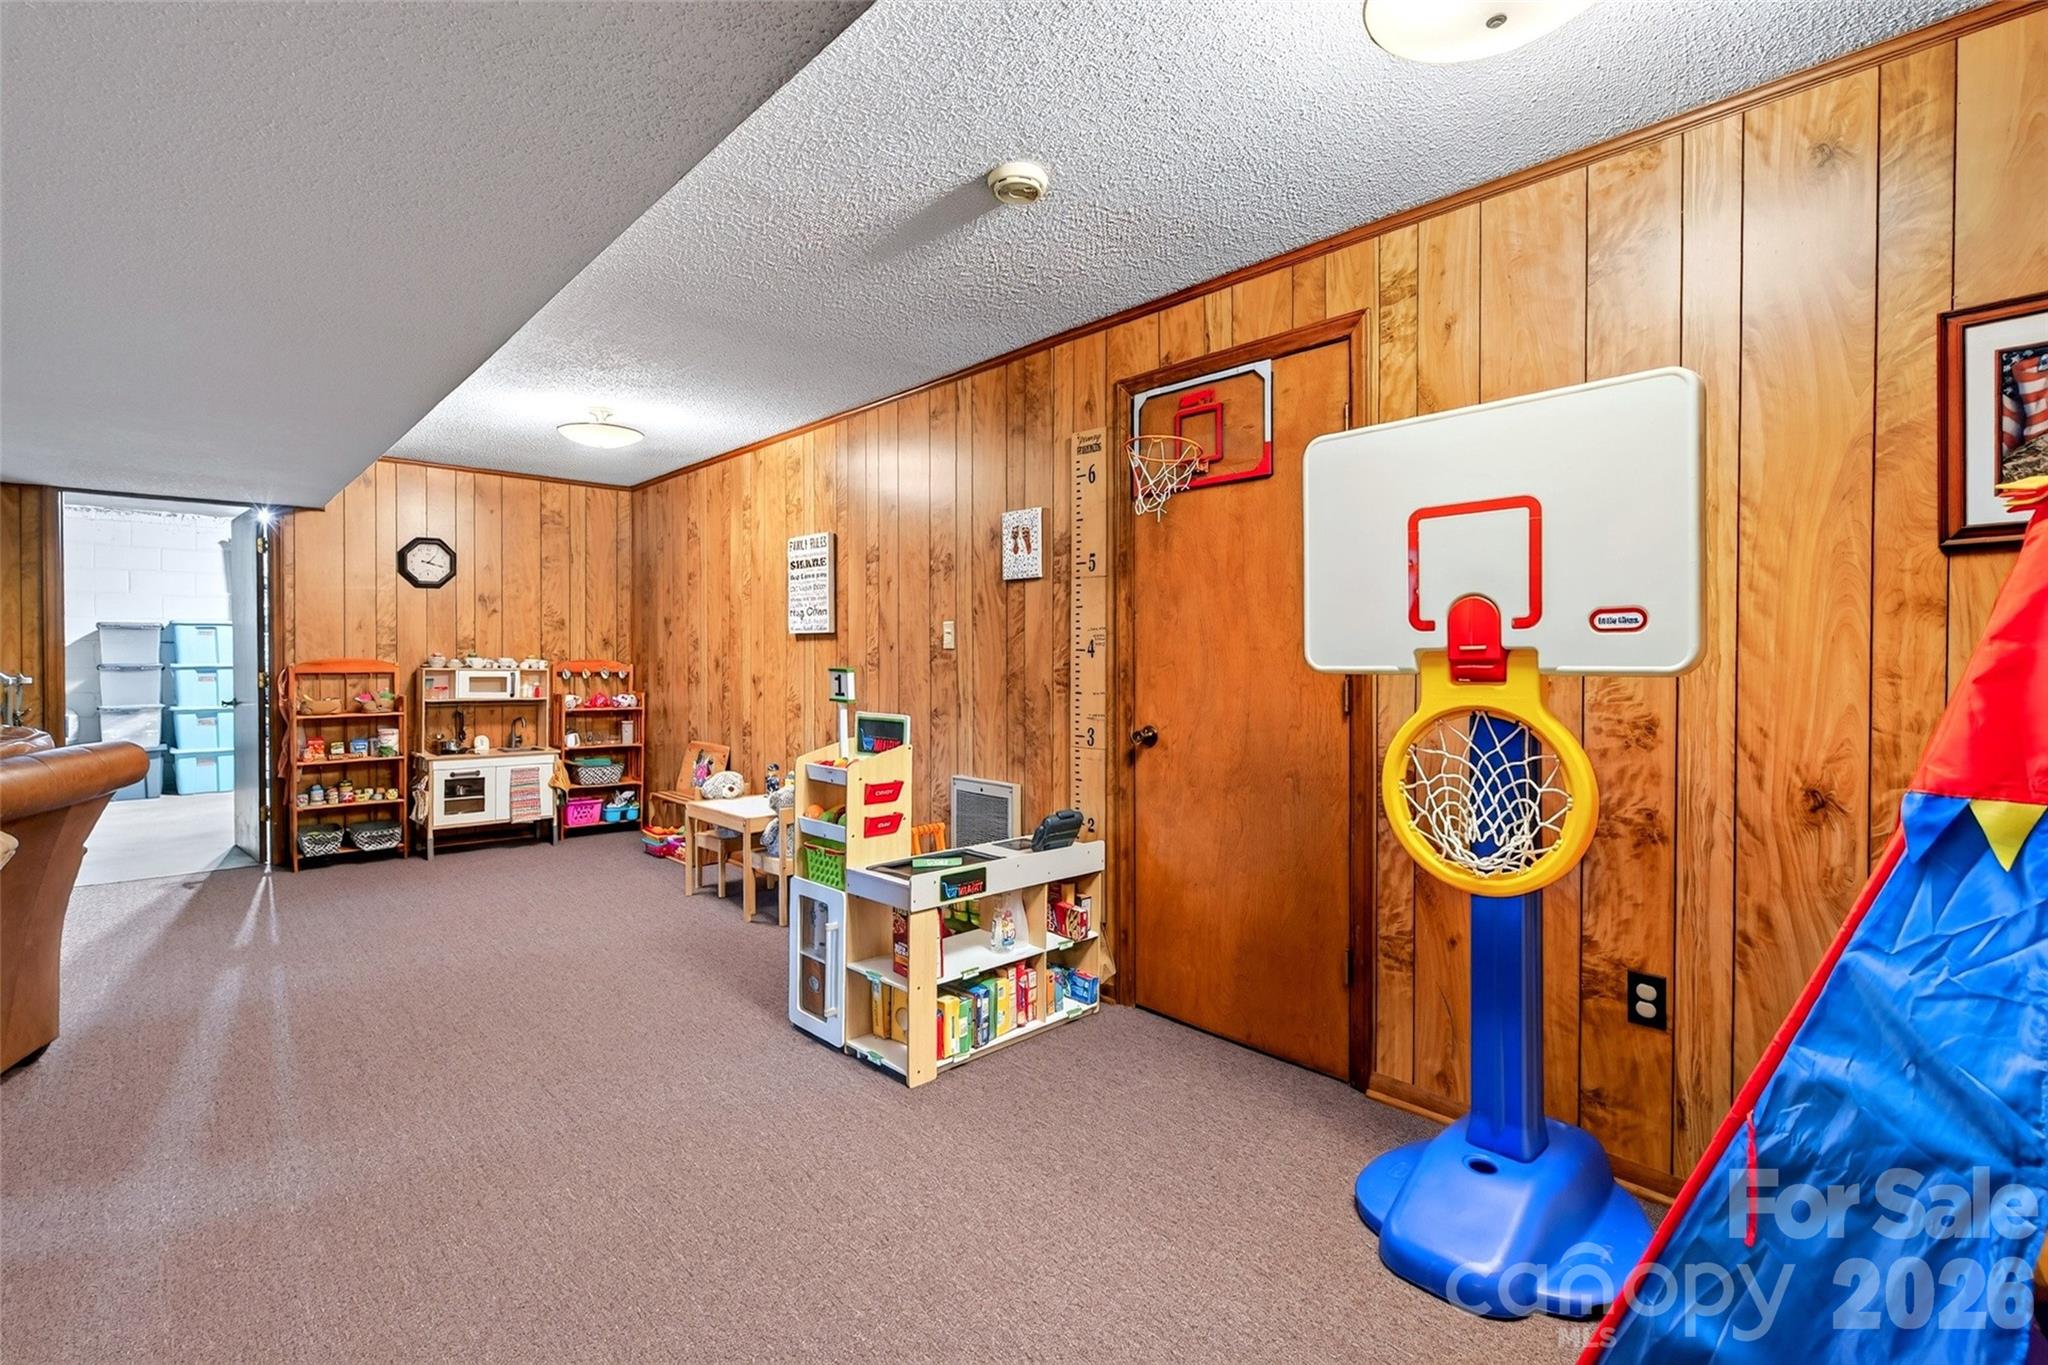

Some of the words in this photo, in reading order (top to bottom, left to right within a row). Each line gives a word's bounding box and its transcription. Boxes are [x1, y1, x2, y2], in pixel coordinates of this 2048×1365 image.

[1088, 464, 1096, 484] 6
[1088, 553, 1096, 572] 5
[1087, 639, 1095, 658] 4
[834, 674, 845, 696] 1
[1087, 728, 1095, 746] 3
[1087, 818, 1095, 832] 2
